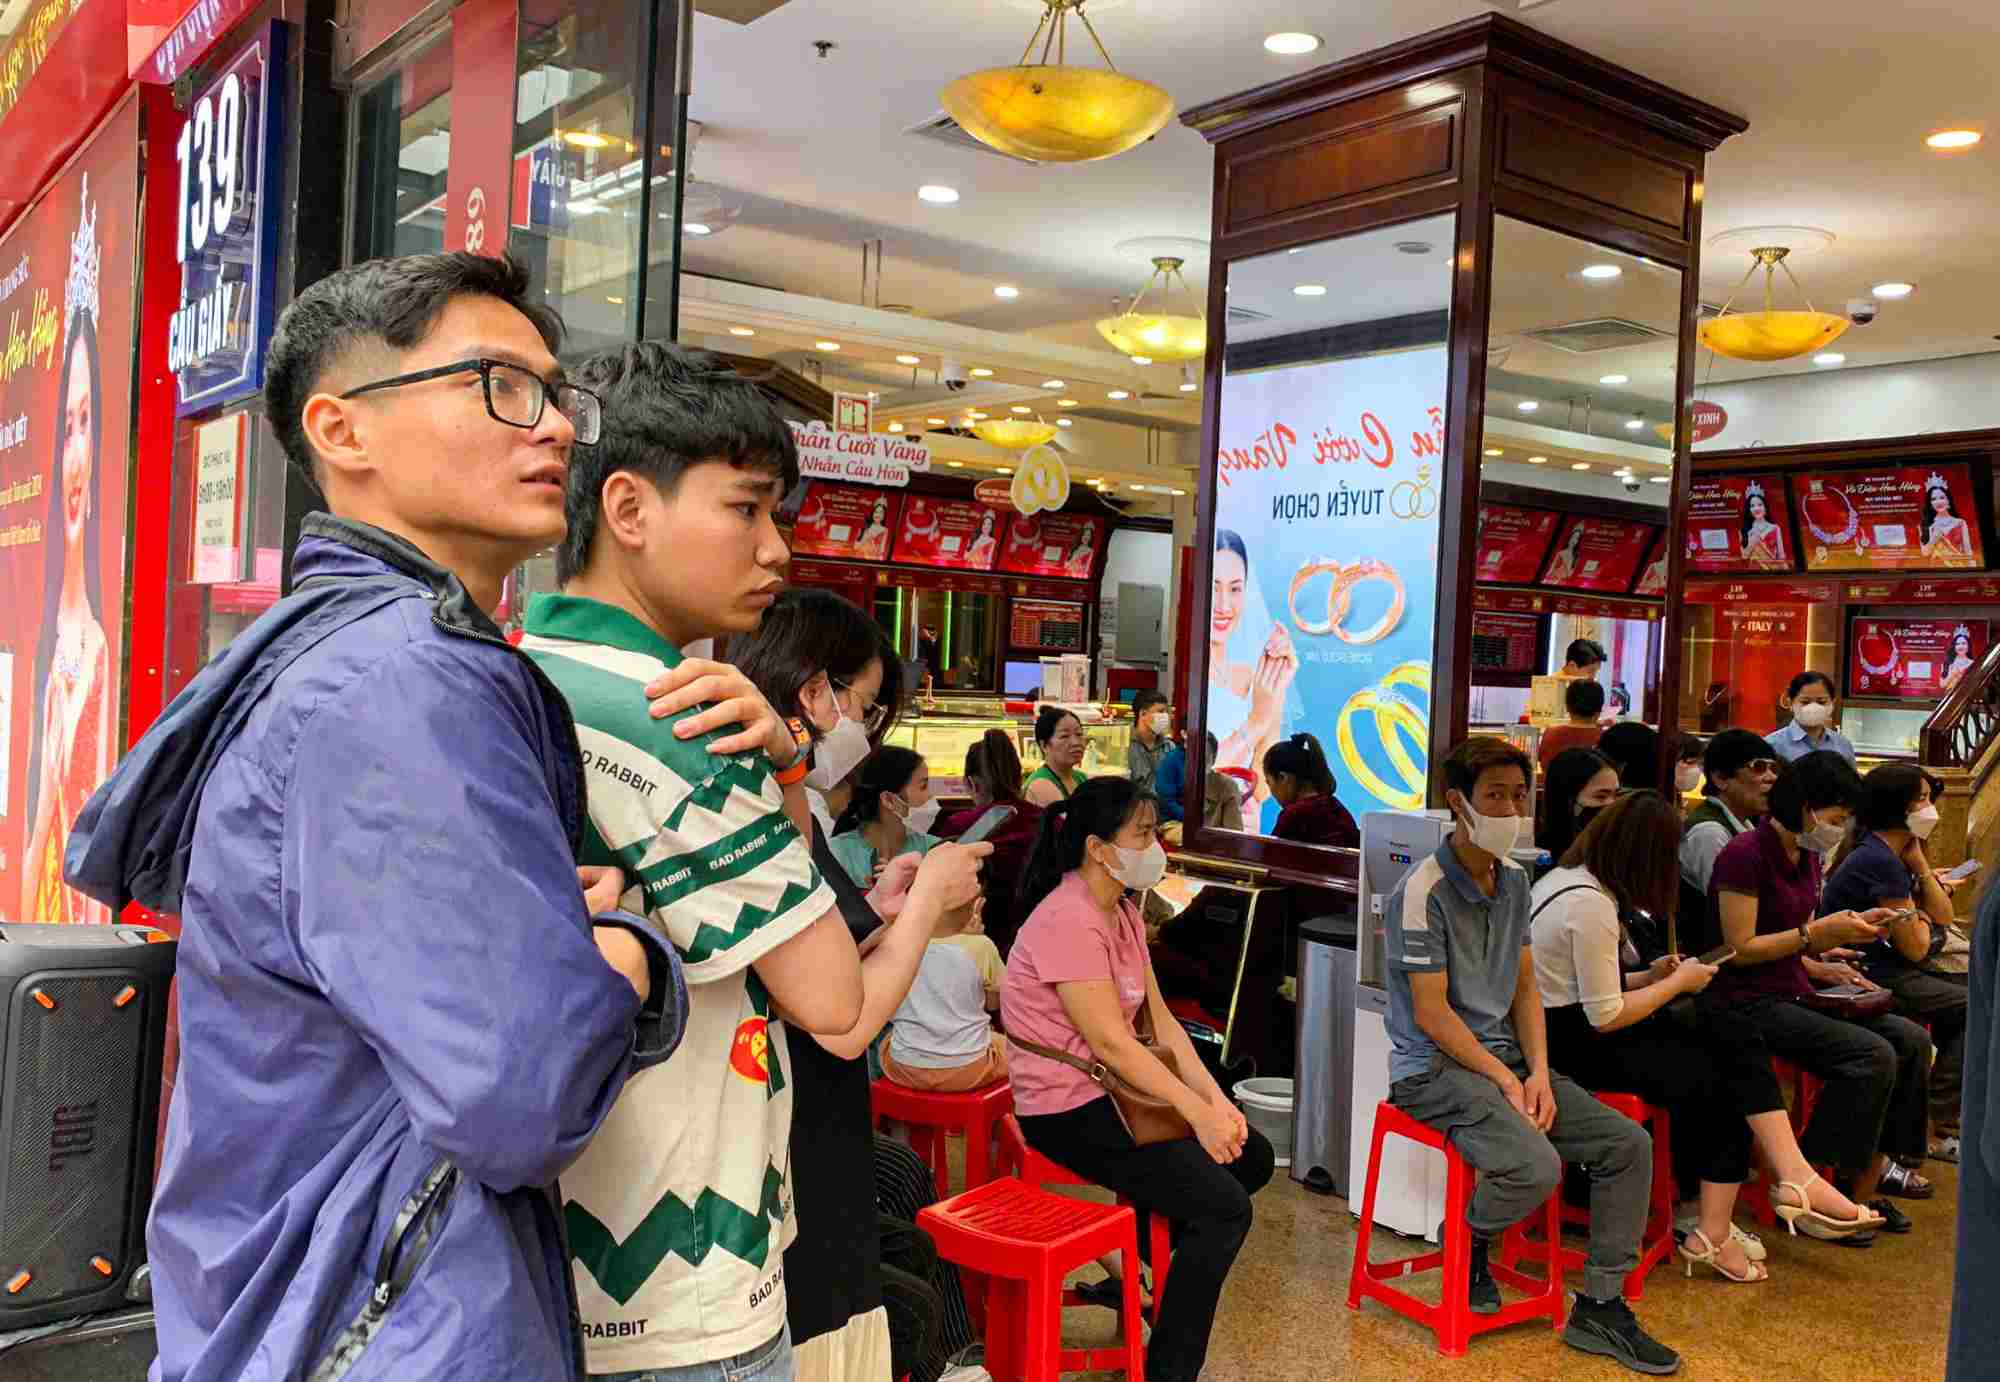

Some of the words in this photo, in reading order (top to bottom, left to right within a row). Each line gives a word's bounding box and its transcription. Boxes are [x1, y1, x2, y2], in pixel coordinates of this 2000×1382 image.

[176, 73, 240, 264] 139
[167, 287, 198, 374] CẦU
[197, 260, 233, 361] GIẤY
[836, 433, 878, 456] Cưới
[882, 439, 928, 466] Vàng
[800, 455, 842, 473] Nhẫn
[846, 460, 873, 476] Cầu
[877, 466, 905, 481] Hôn
[1747, 620, 1774, 632] ITALY
[594, 755, 658, 797] RABBIT
[652, 865, 692, 892] RABBIT
[709, 851, 735, 871] BAD
[749, 1281, 773, 1309] BAD
[580, 1318, 649, 1339] RABBIT
